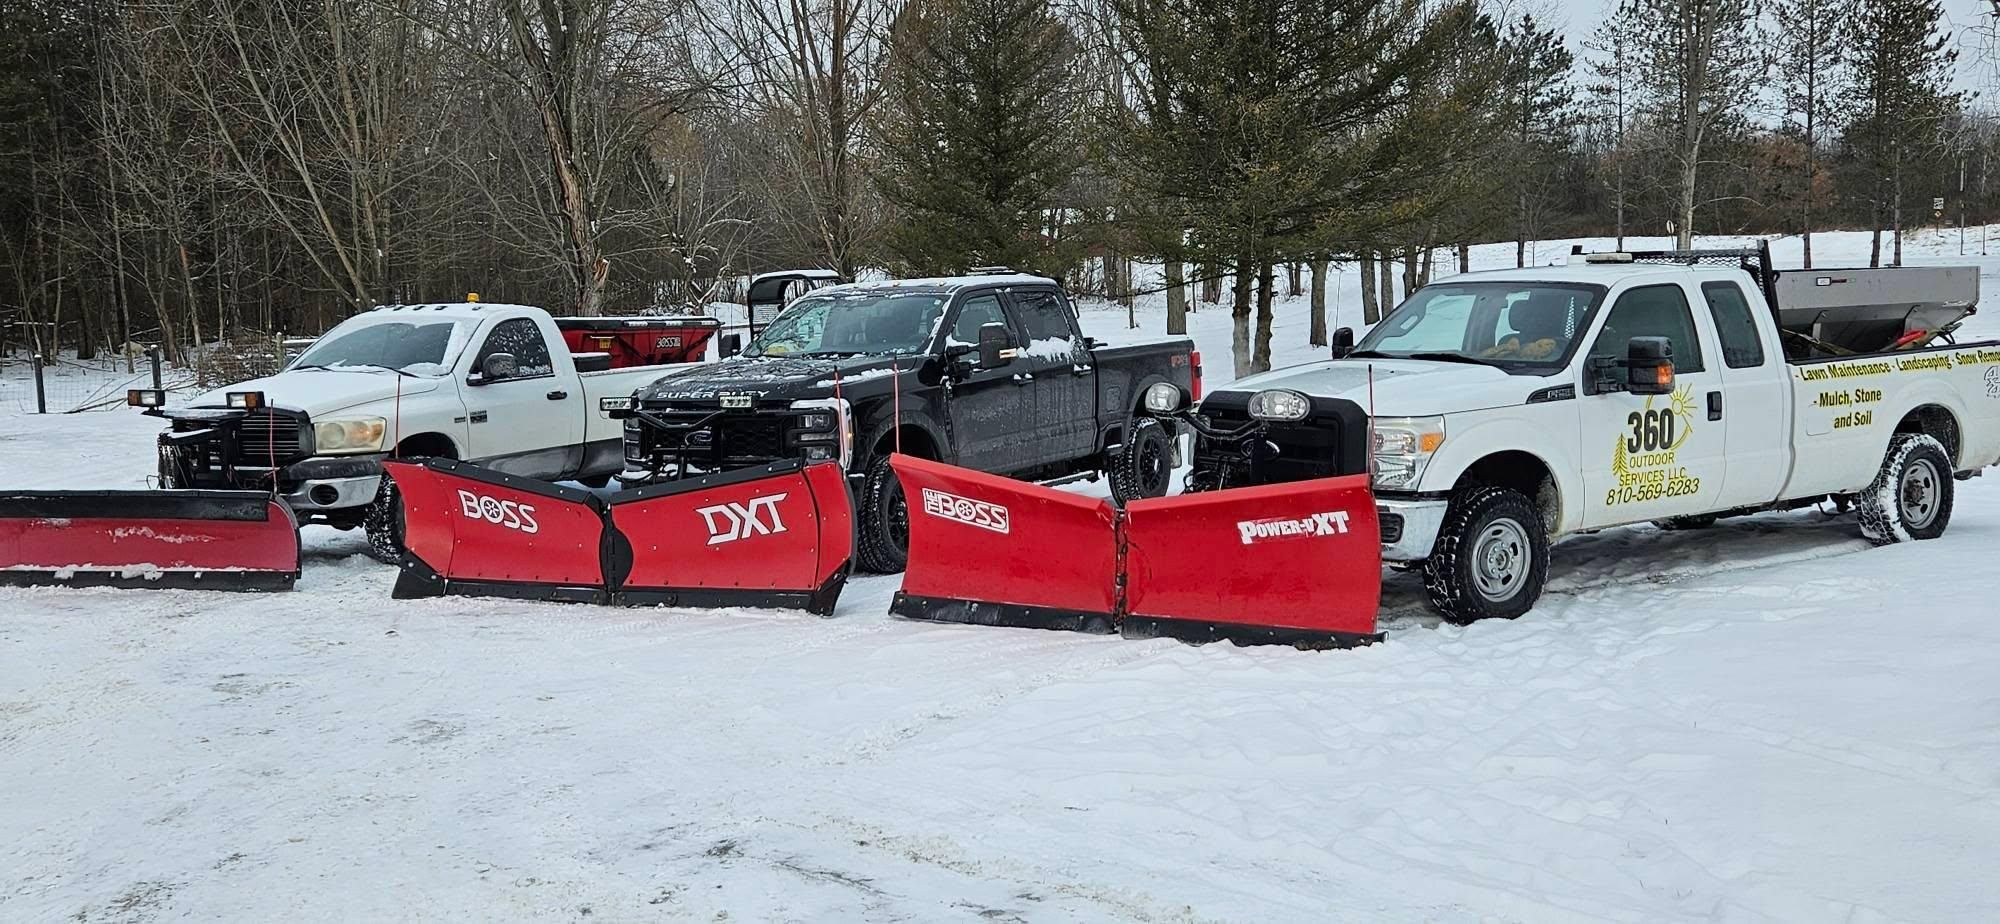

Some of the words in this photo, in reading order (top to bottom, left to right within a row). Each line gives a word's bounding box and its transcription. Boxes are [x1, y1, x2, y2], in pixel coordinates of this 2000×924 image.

[1800, 367, 1828, 382] Lawn
[1828, 360, 1891, 378] Maintenance
[1896, 354, 1953, 372] Landscaping
[1955, 351, 1978, 365] Snow
[656, 391, 715, 399] SUPER
[1819, 391, 1853, 408] Mulch,
[1855, 388, 1882, 403] Stone
[1627, 407, 1675, 453] 360
[1834, 413, 1852, 429] and
[1855, 411, 1872, 425] Soil
[1629, 452, 1675, 468] OUTDOOR
[1606, 477, 1700, 506] 810-569-6283
[1619, 470, 1665, 487] SERVICES
[458, 489, 538, 534] BOSS
[696, 493, 788, 546] DXT
[926, 490, 939, 513] THE
[938, 493, 1007, 530] BOSS
